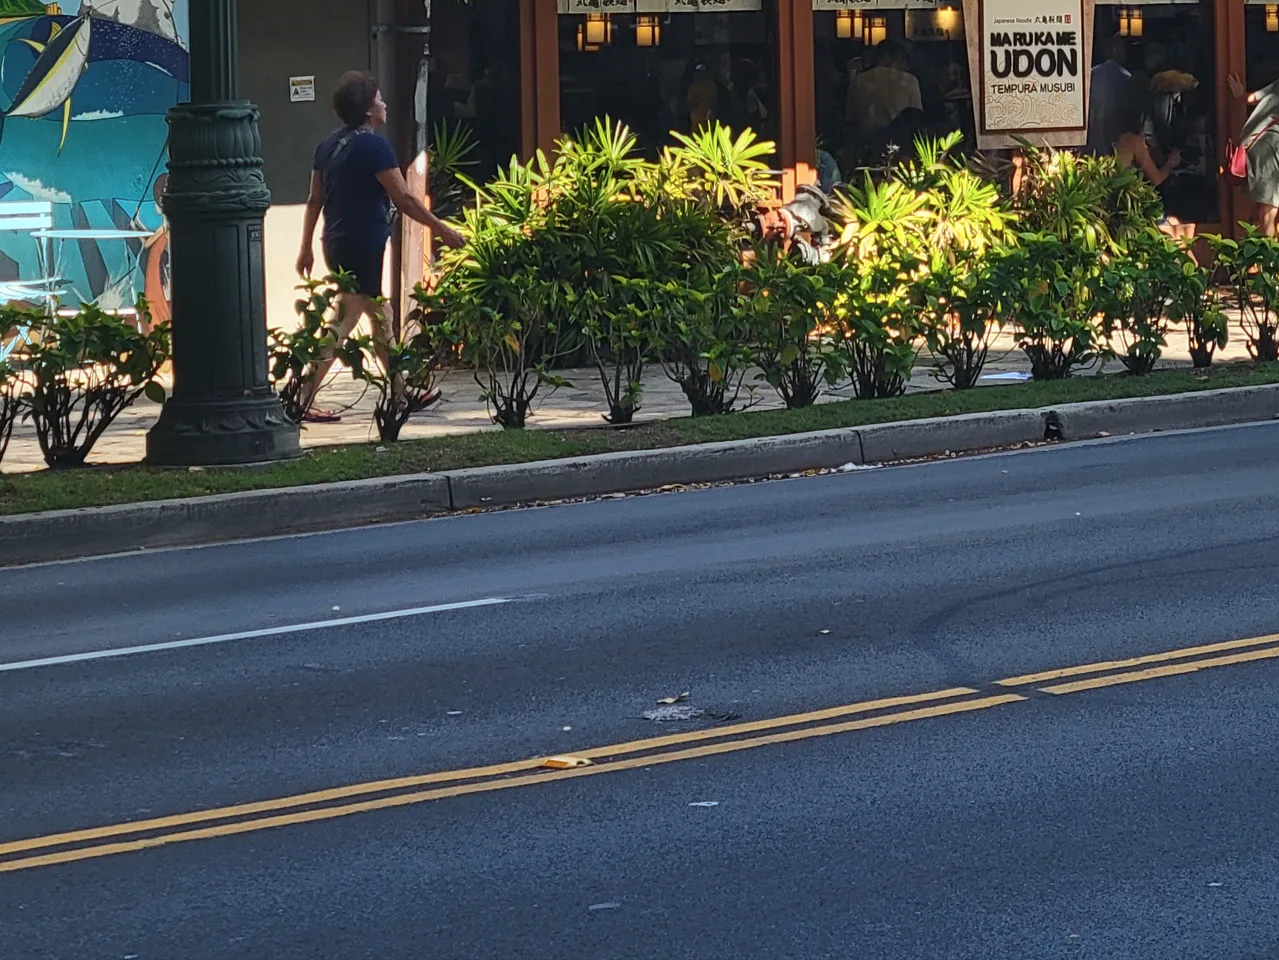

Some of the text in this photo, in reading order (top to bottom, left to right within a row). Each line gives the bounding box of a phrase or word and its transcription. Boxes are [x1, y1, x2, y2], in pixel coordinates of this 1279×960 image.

[990, 31, 1077, 47] MARUKAME
[990, 48, 1078, 79] UDON
[991, 82, 1076, 94] TEMPURA MUSUBI
